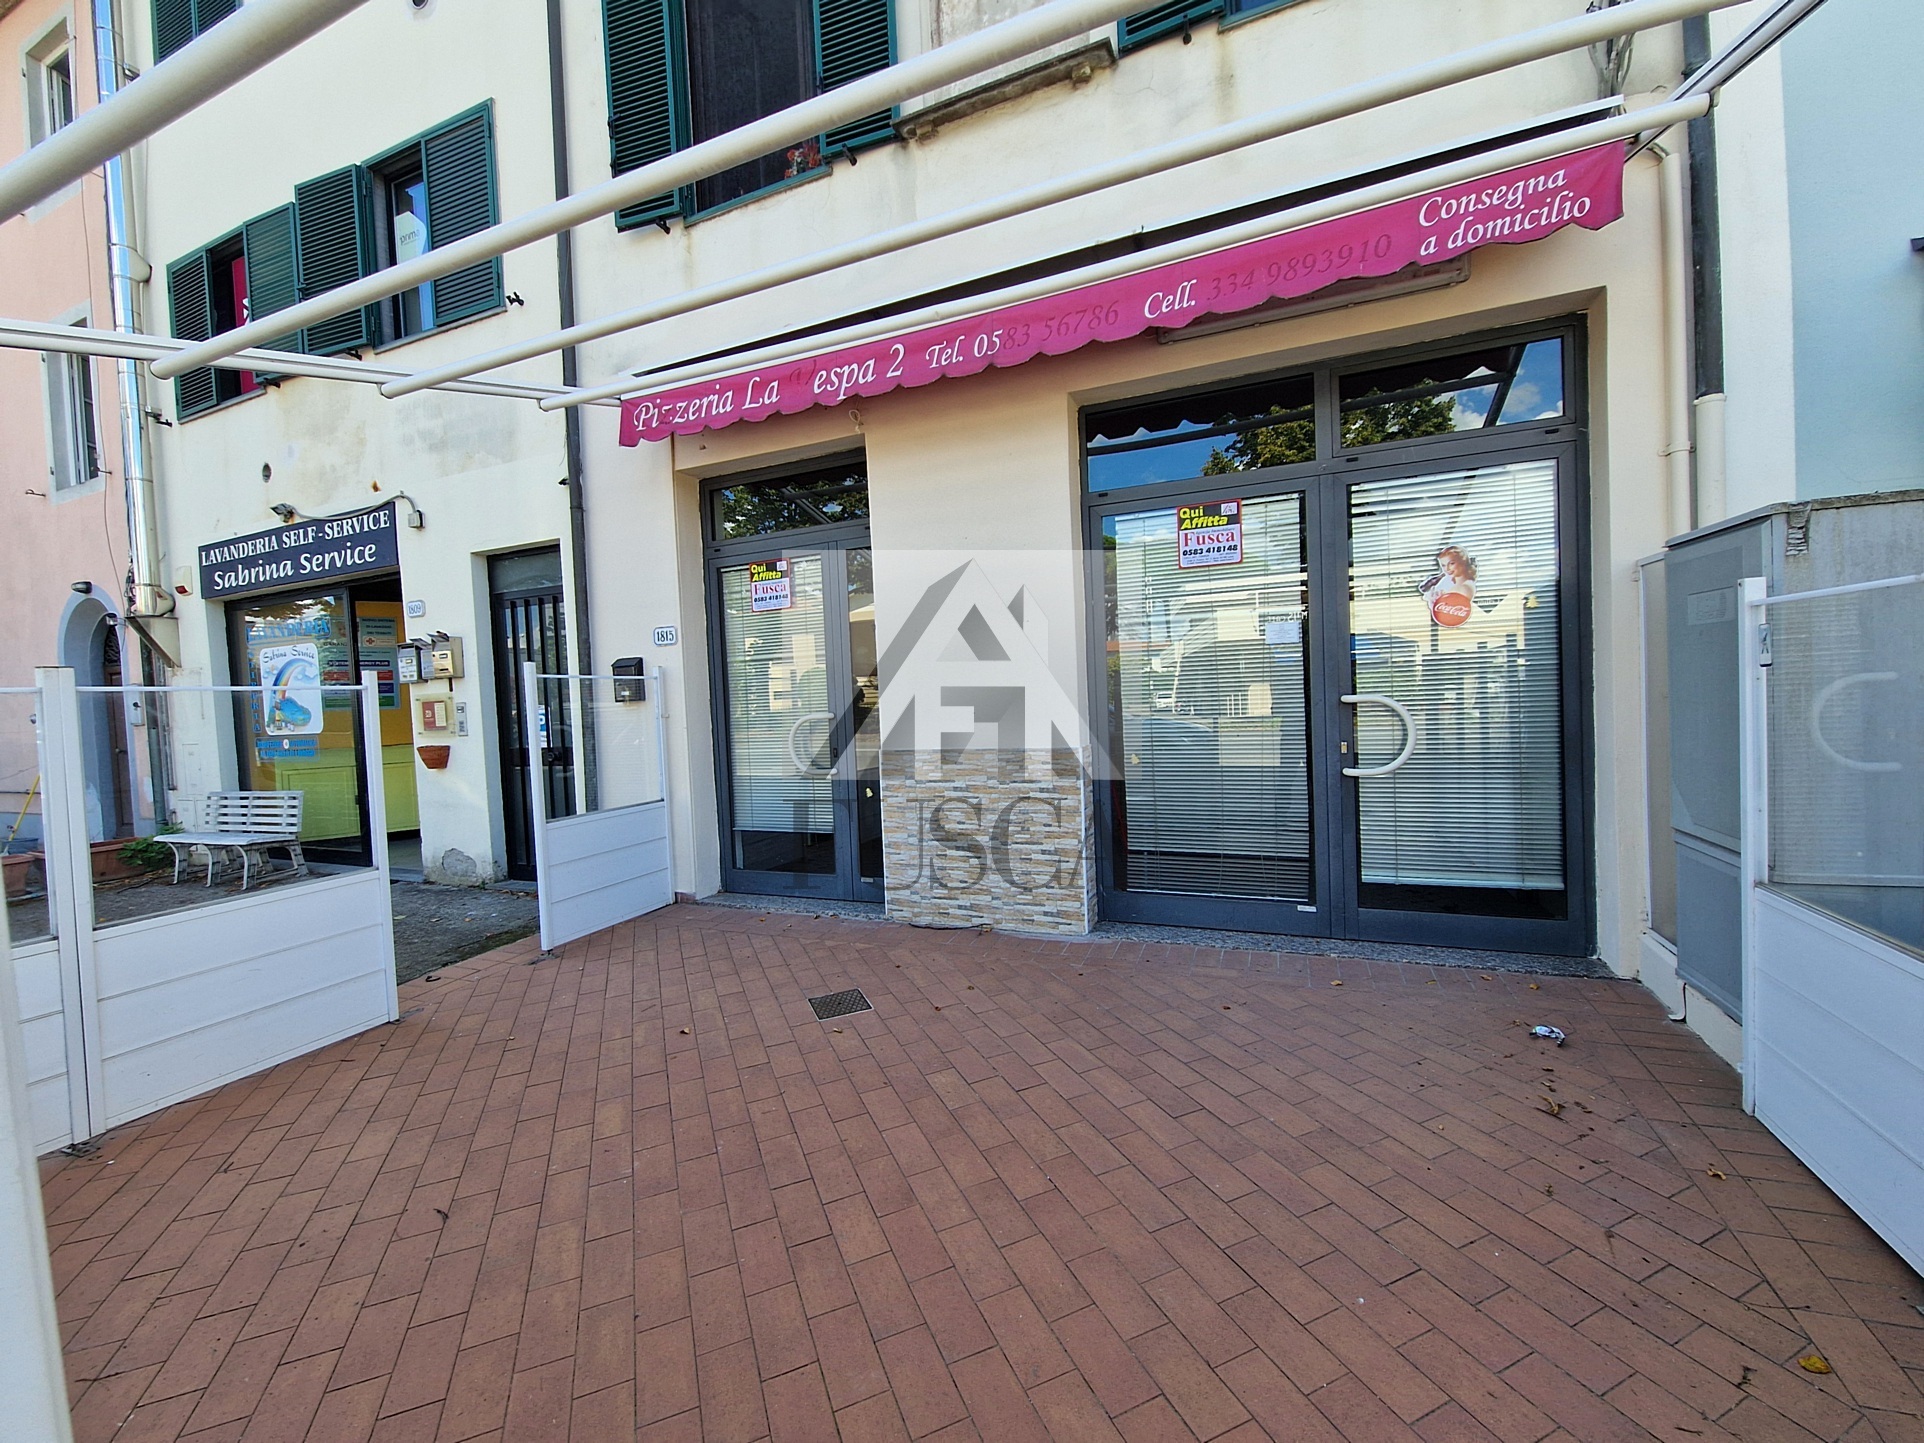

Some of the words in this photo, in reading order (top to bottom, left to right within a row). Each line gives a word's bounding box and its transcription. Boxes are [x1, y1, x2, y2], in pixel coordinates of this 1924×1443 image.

[1419, 169, 1567, 227] Consegna
[1419, 234, 1438, 256] a
[1447, 190, 1591, 250] domicilio
[742, 376, 781, 409] La
[886, 343, 906, 378] 2
[925, 335, 964, 368] Tel.
[1144, 279, 1197, 319] Cell.
[1180, 506, 1204, 519] Qui
[1180, 515, 1228, 530] Affitta
[1183, 531, 1235, 547] Fusca
[201, 534, 279, 566] LAVANDERIA
[1182, 548, 1204, 557] 0583
[1205, 544, 1238, 554] 418148
[214, 559, 294, 590] Sabrina
[300, 542, 377, 574] Service
[751, 563, 767, 573] Qui
[752, 571, 782, 582] Affitta
[754, 583, 786, 595] Fusca
[657, 630, 675, 643] 1815
